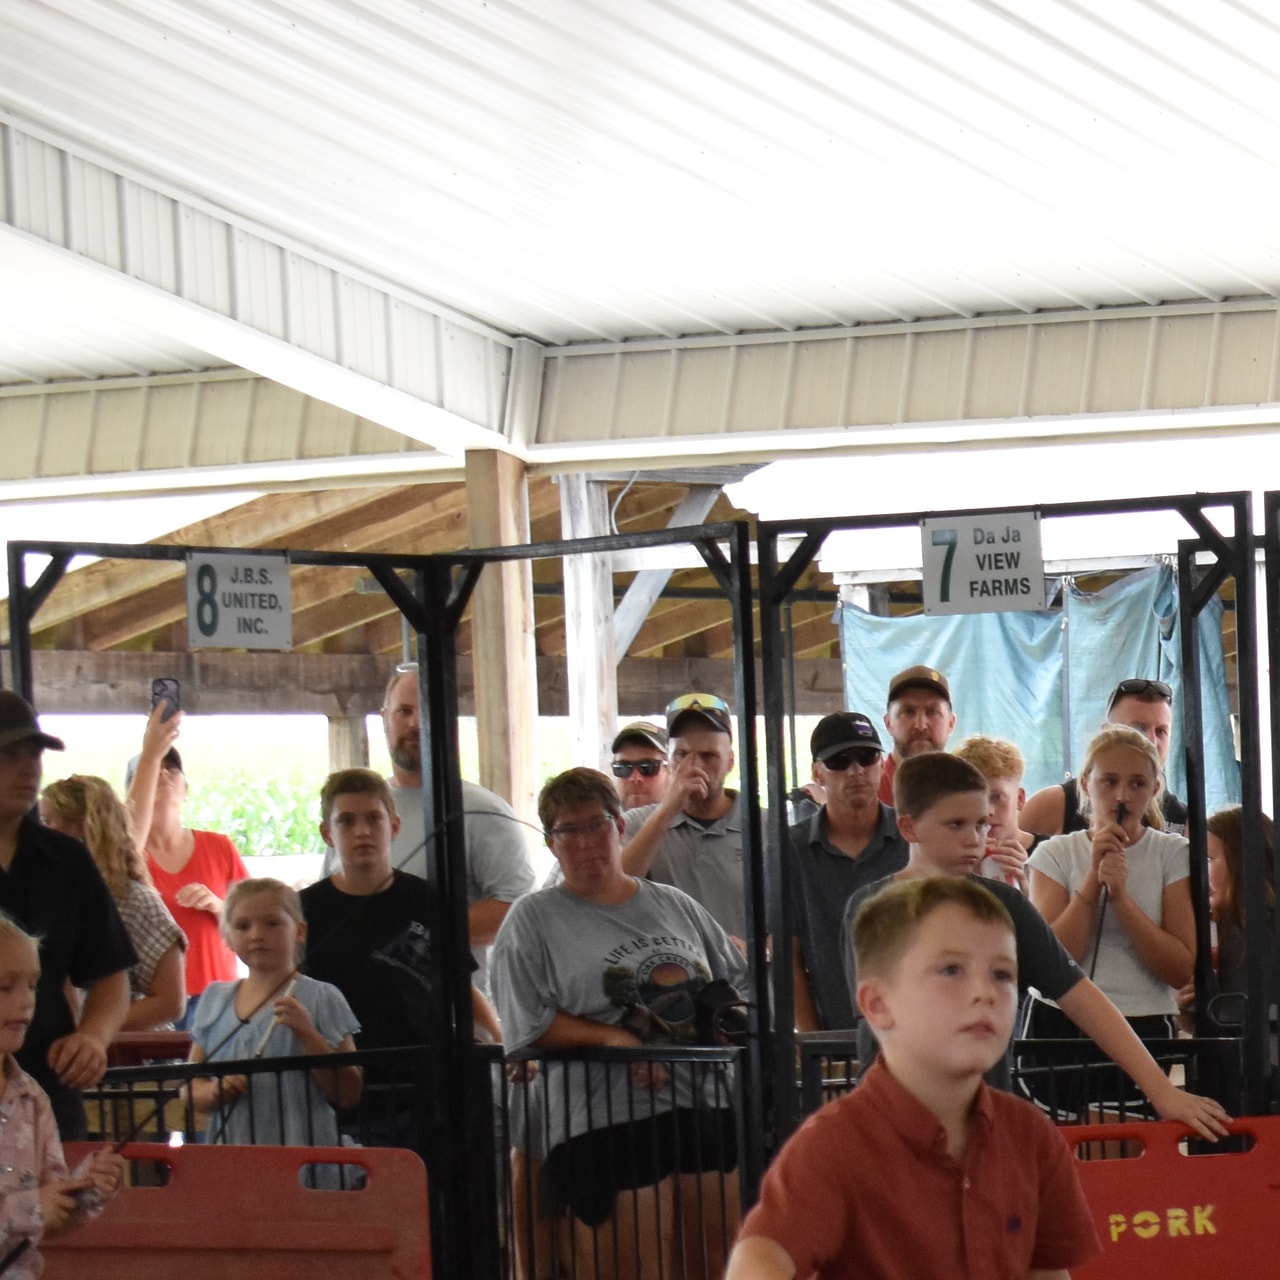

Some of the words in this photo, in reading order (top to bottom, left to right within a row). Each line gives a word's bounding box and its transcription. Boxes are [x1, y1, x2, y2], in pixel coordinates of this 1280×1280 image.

[973, 528, 995, 545] Da
[1001, 526, 1021, 543] Ja
[931, 529, 958, 602] 7
[975, 551, 1021, 571] VIEW
[230, 567, 273, 585] J.B.S.
[969, 577, 1031, 598] FARMS
[196, 563, 219, 637] 8
[222, 592, 283, 613] UNITED,
[236, 617, 269, 635] INC.
[604, 945, 634, 965] LIFE
[631, 938, 649, 950] IS
[1109, 1205, 1217, 1242] PORK
